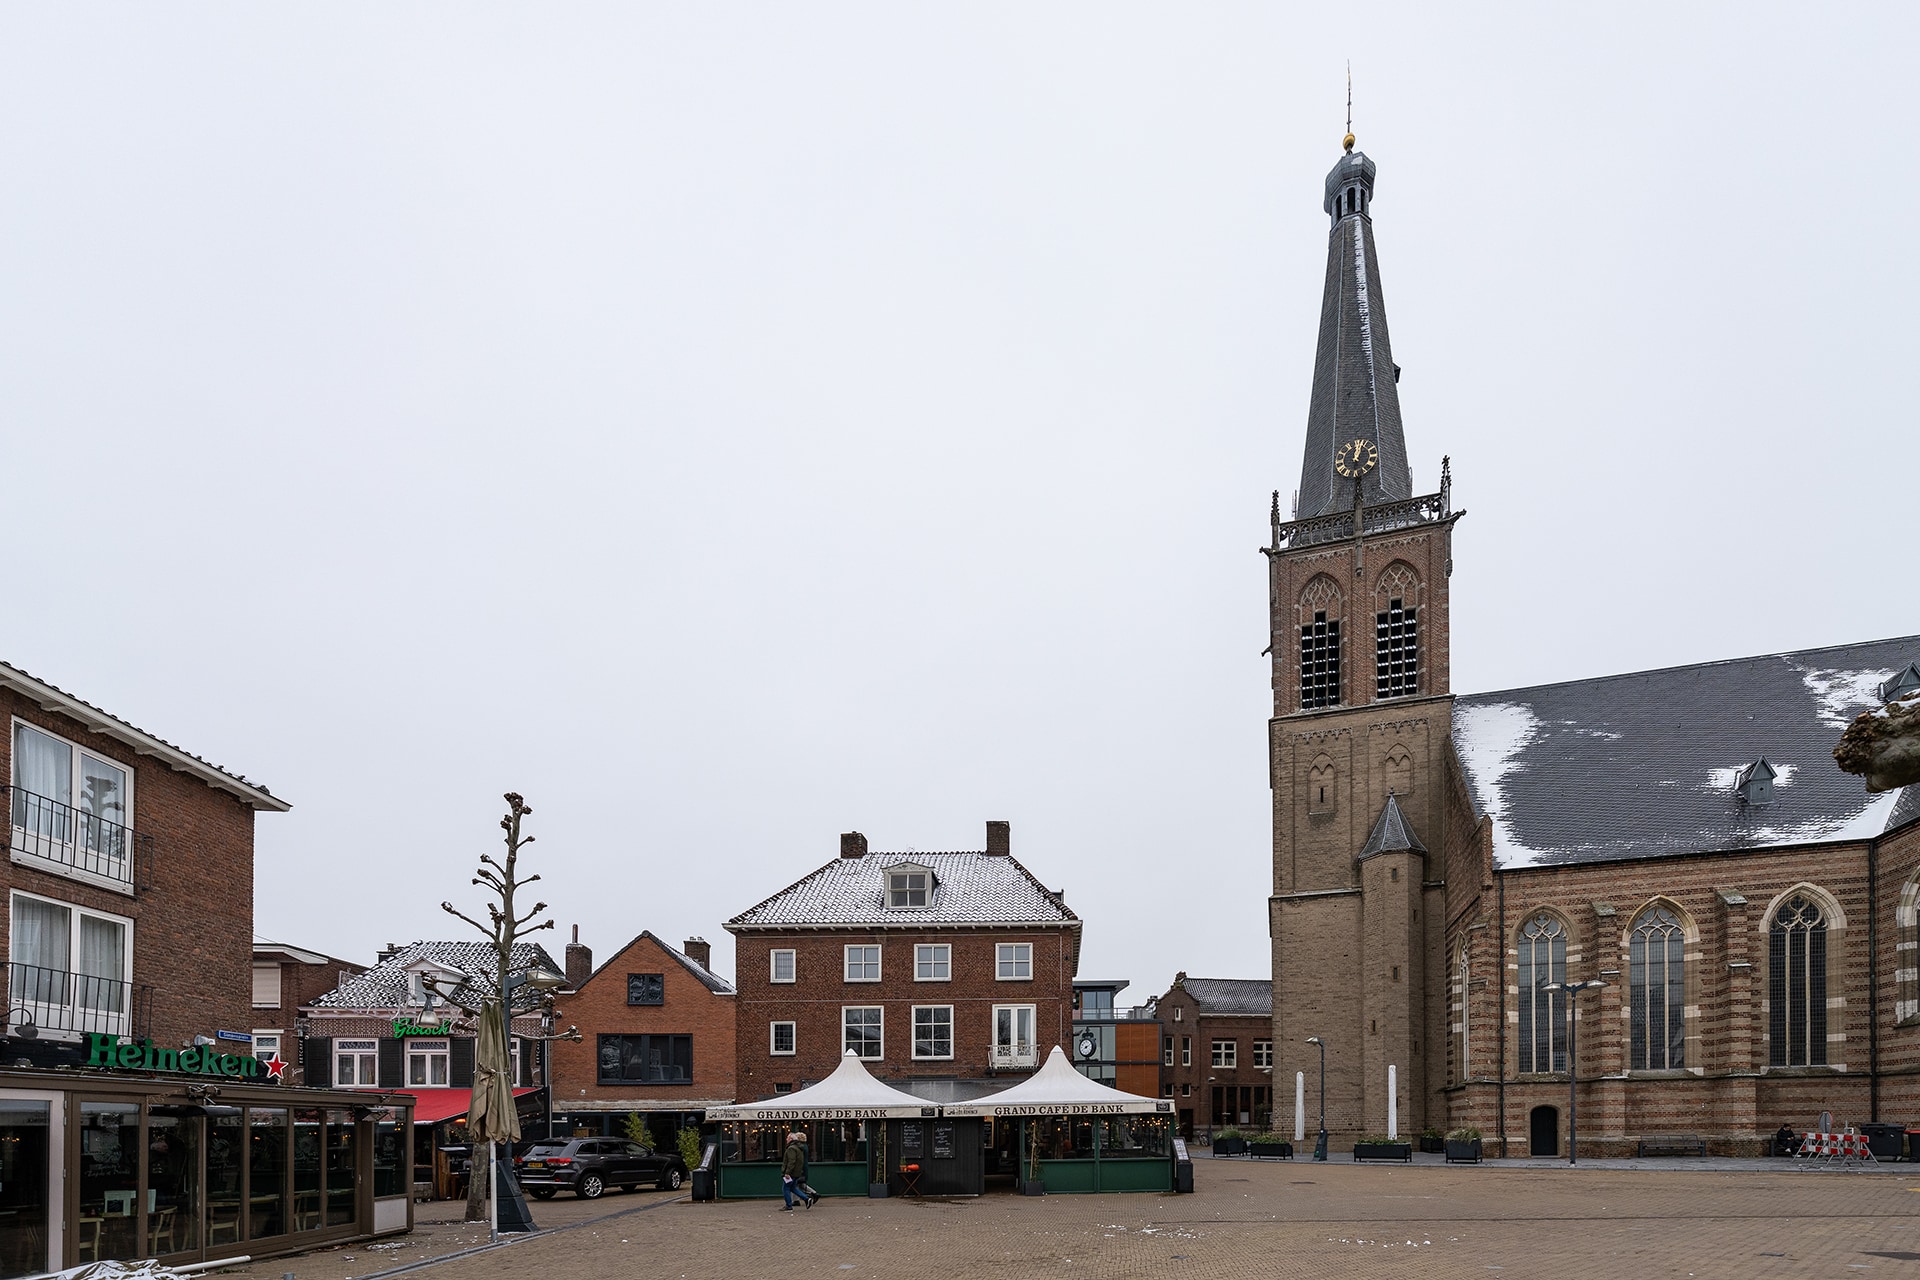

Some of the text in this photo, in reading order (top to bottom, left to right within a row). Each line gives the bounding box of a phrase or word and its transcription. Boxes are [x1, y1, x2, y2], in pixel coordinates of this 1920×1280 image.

[87, 1032, 258, 1077] Heineken
[757, 1108, 887, 1119] GRAND CAFÉ DE BANK
[994, 1104, 1124, 1115] GRAND CAFÉ DE BANK
